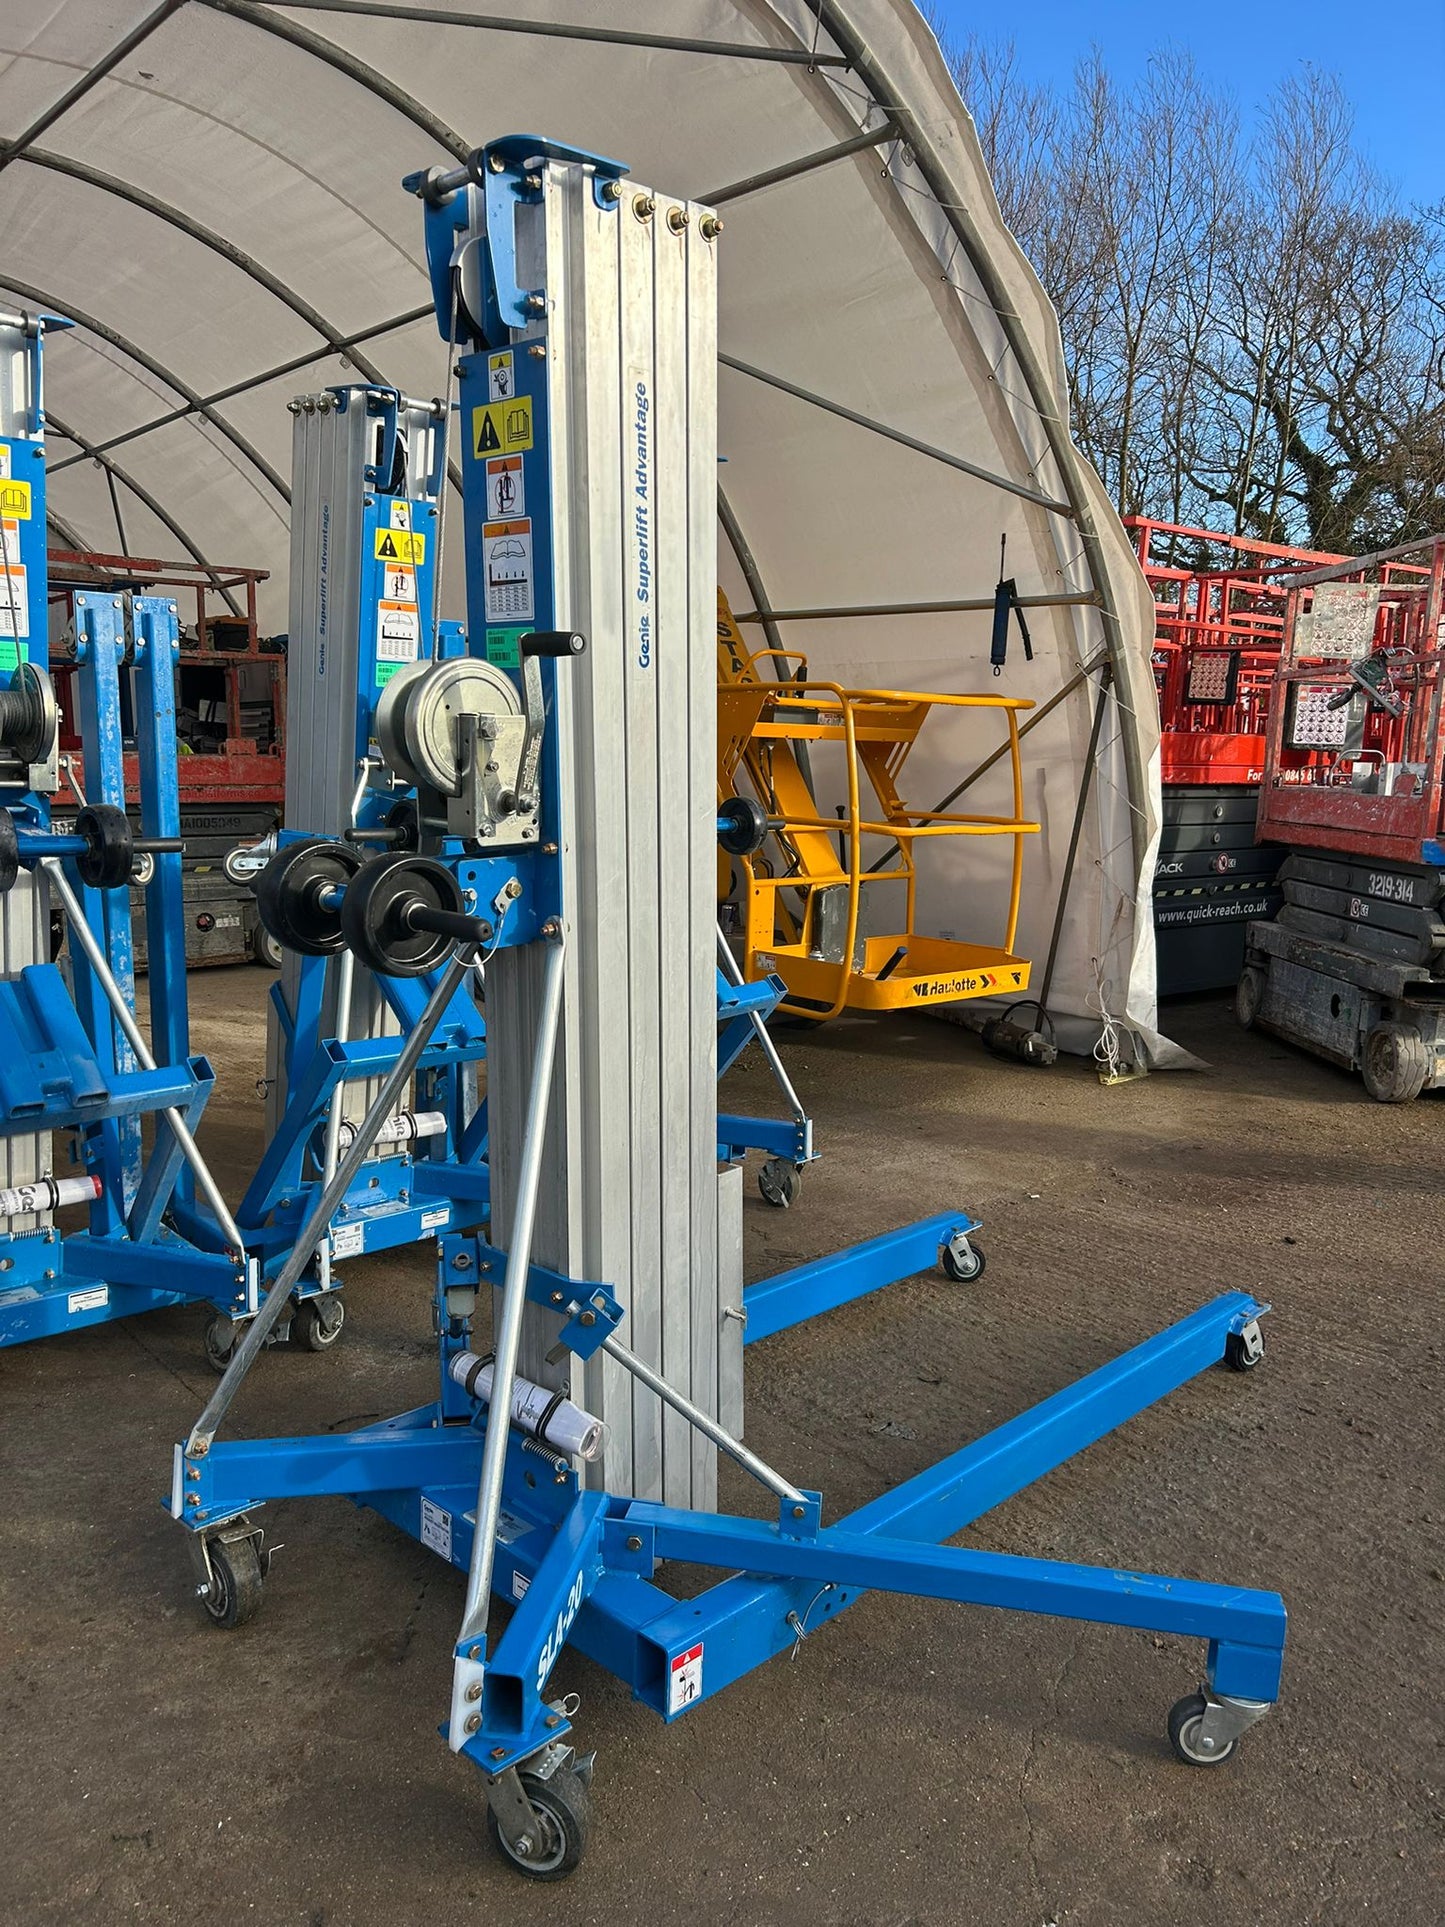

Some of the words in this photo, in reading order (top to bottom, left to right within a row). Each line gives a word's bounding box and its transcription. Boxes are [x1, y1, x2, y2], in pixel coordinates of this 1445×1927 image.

[635, 382, 650, 500] Advantage
[321, 505, 329, 574] Advantage
[635, 505, 651, 603] Superlift
[319, 578, 328, 635] Superlift
[638, 615, 650, 669] Genie
[1247, 769, 1263, 781] For
[1158, 898, 1268, 923] www.quick-reach.co.uk
[536, 1569, 584, 1692] SLA-20
